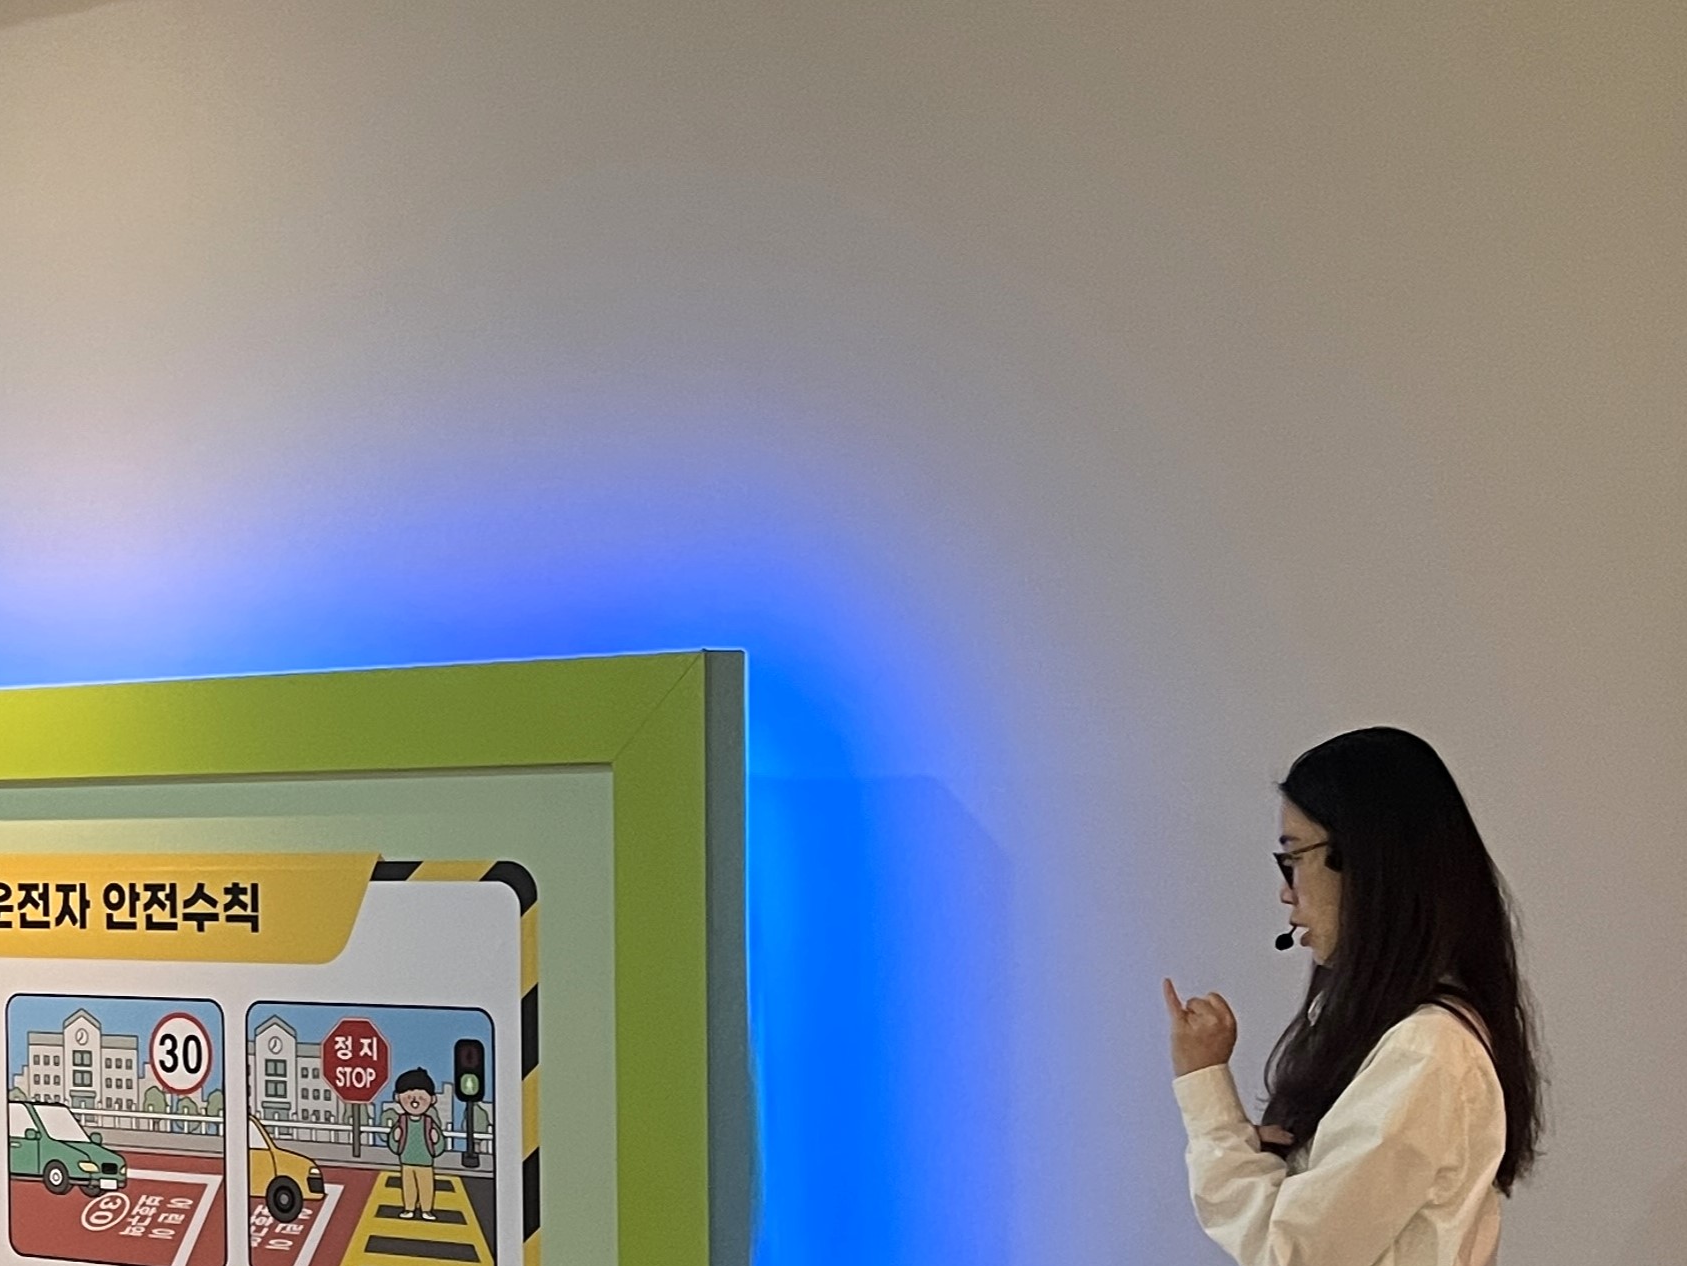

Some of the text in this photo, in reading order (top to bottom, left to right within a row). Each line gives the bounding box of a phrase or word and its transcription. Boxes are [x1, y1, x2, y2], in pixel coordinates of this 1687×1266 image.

[102, 881, 261, 933] 안전수칙
[158, 1032, 203, 1075] 30
[335, 1066, 378, 1089] STOP
